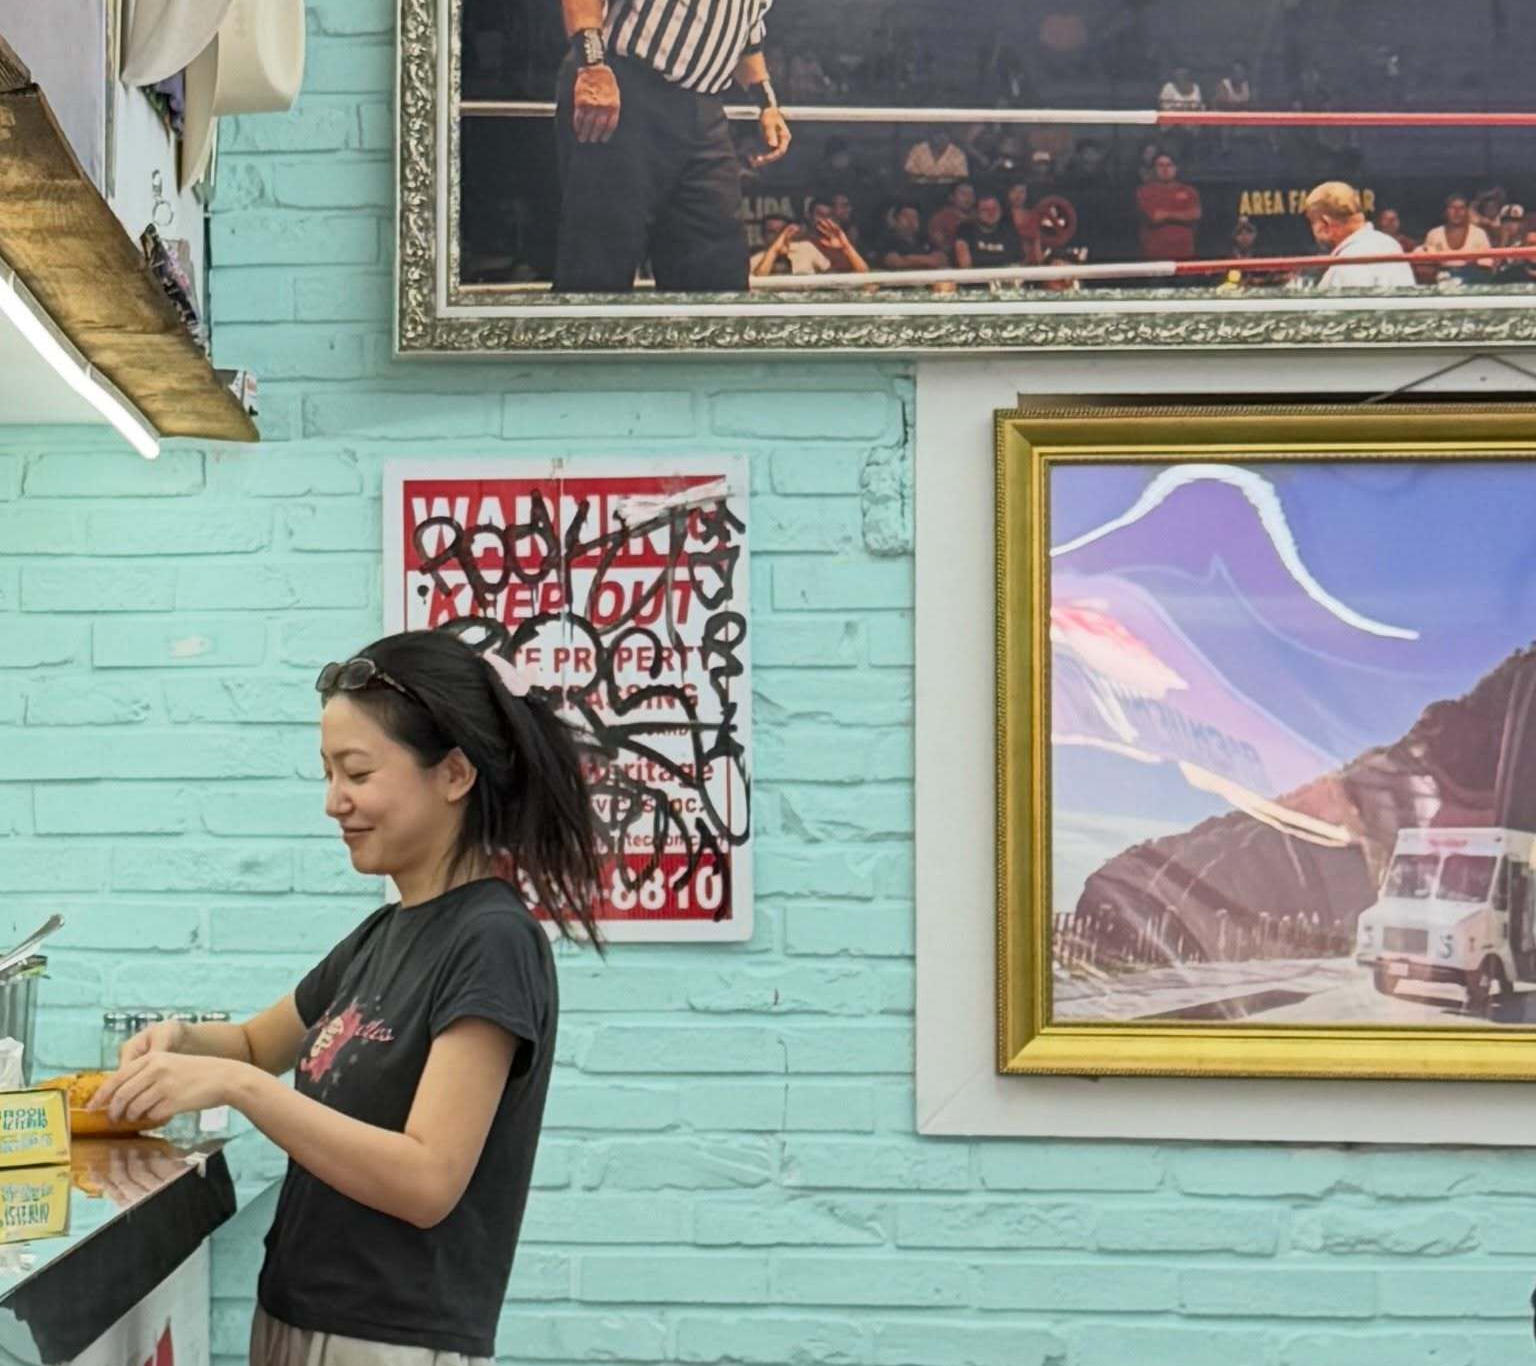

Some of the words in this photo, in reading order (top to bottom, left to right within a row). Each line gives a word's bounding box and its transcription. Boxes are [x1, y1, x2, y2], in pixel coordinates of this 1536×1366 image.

[1239, 189, 1285, 216] AREA
[590, 579, 704, 626] OUT
[553, 646, 710, 673] PRPERTY
